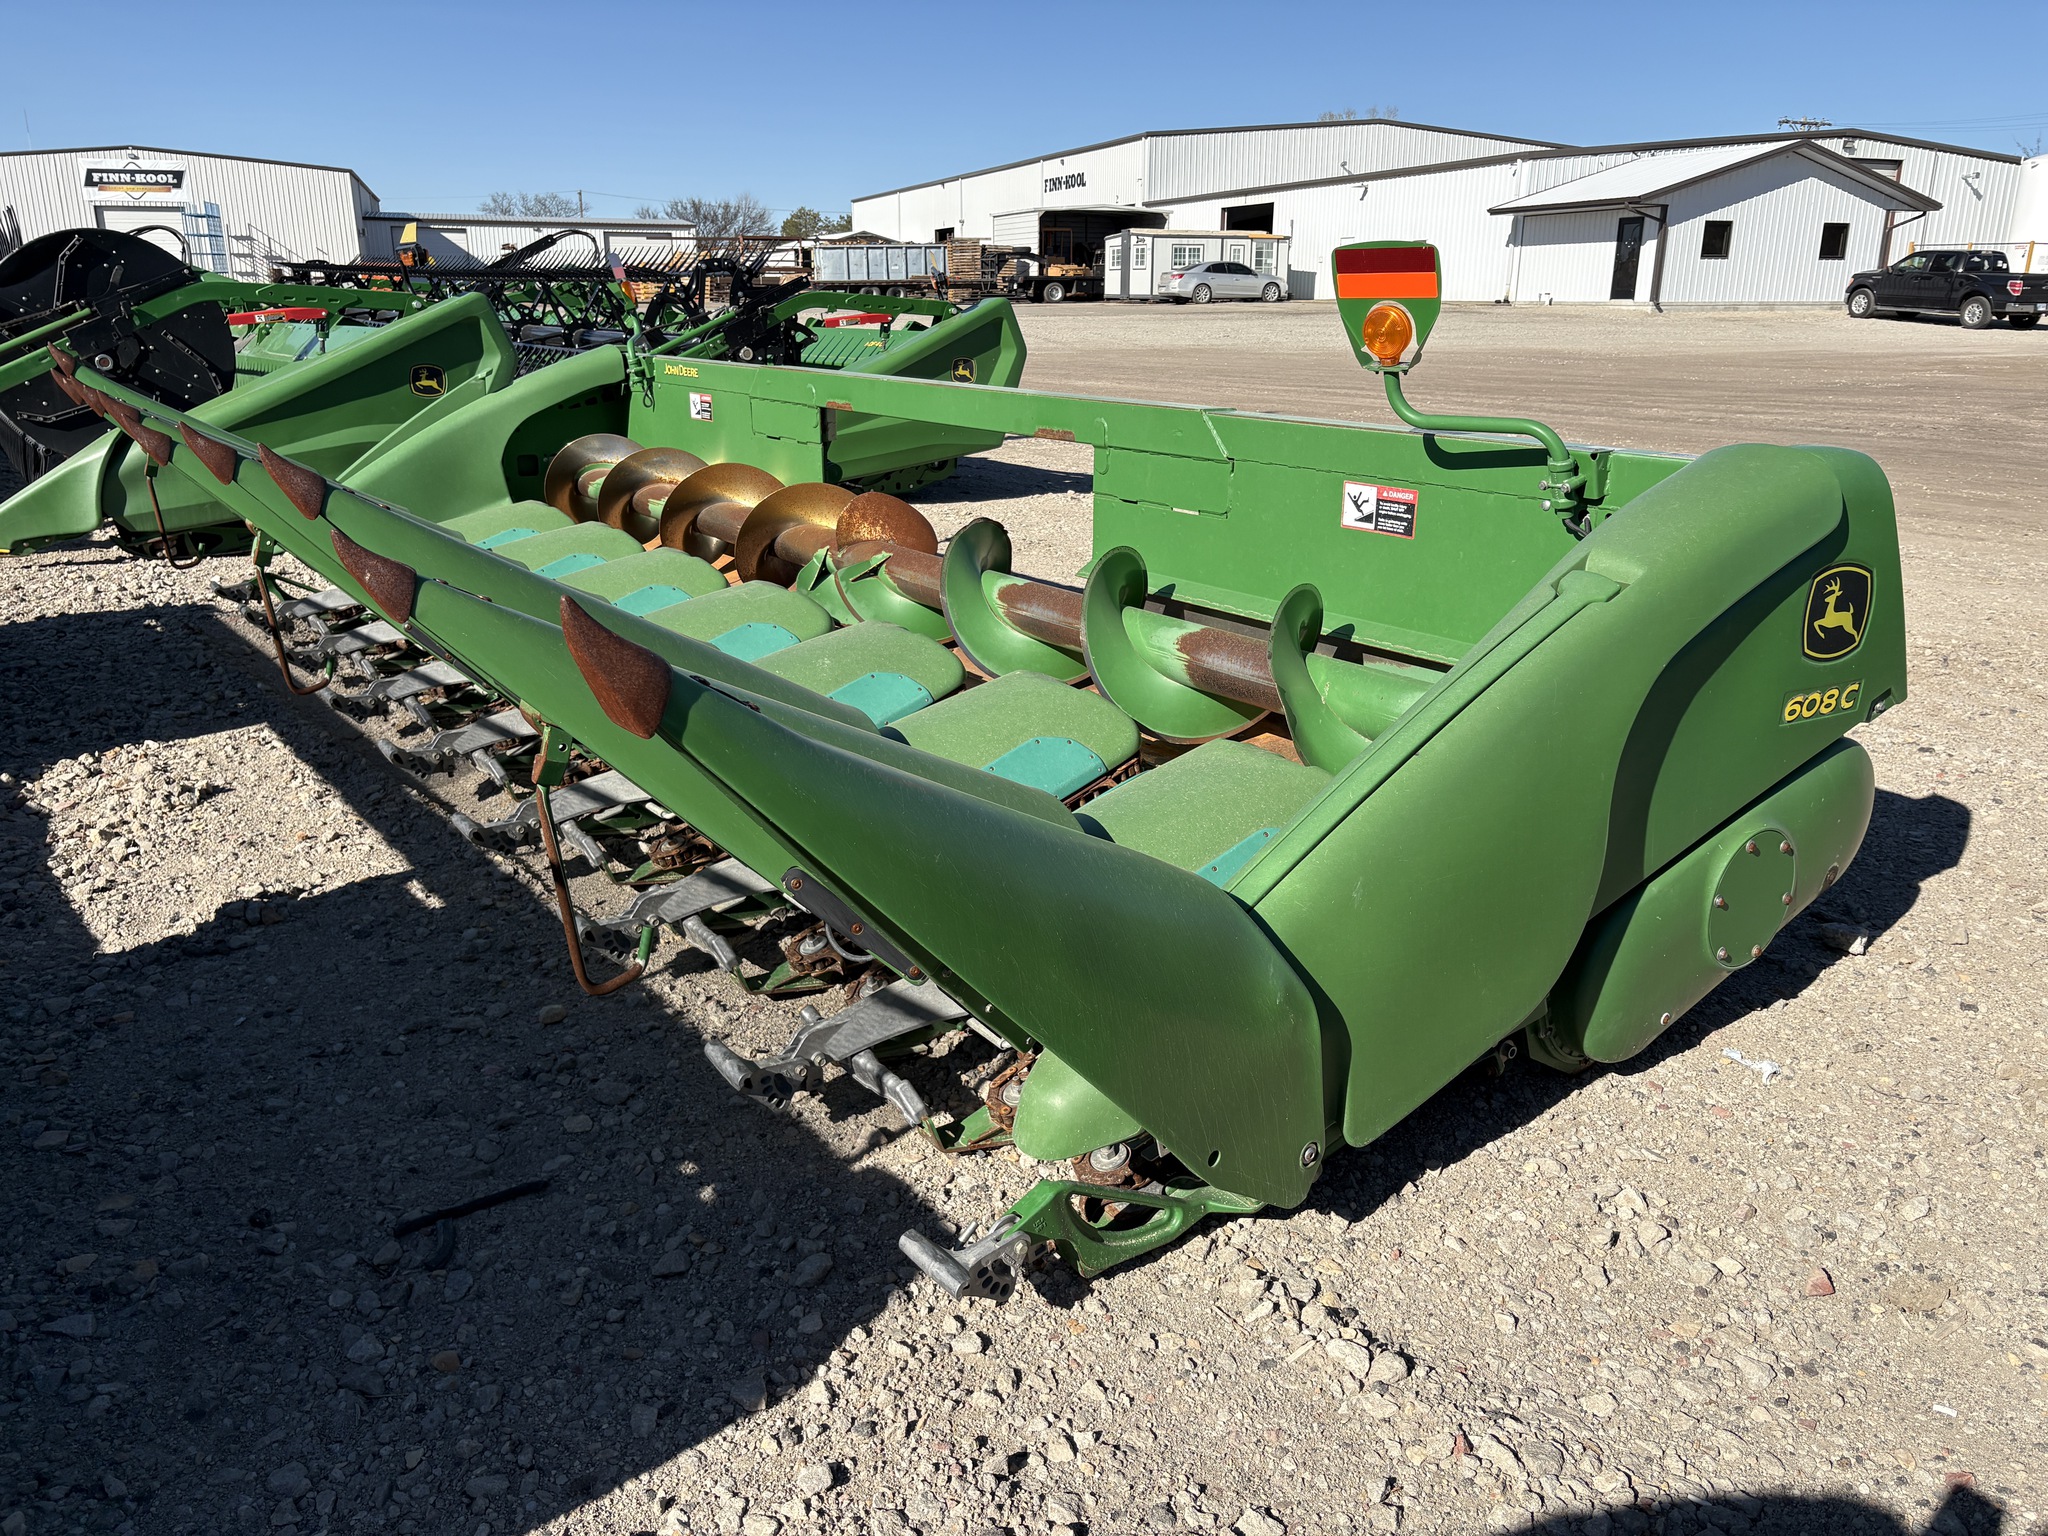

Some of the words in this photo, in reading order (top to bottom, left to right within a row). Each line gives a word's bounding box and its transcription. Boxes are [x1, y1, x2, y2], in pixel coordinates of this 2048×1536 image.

[91, 172, 178, 184] FINN-KOOL
[1044, 172, 1086, 193] FINN-KOOL
[1388, 490, 1414, 501] DANGER
[1784, 682, 1860, 723] 608C
